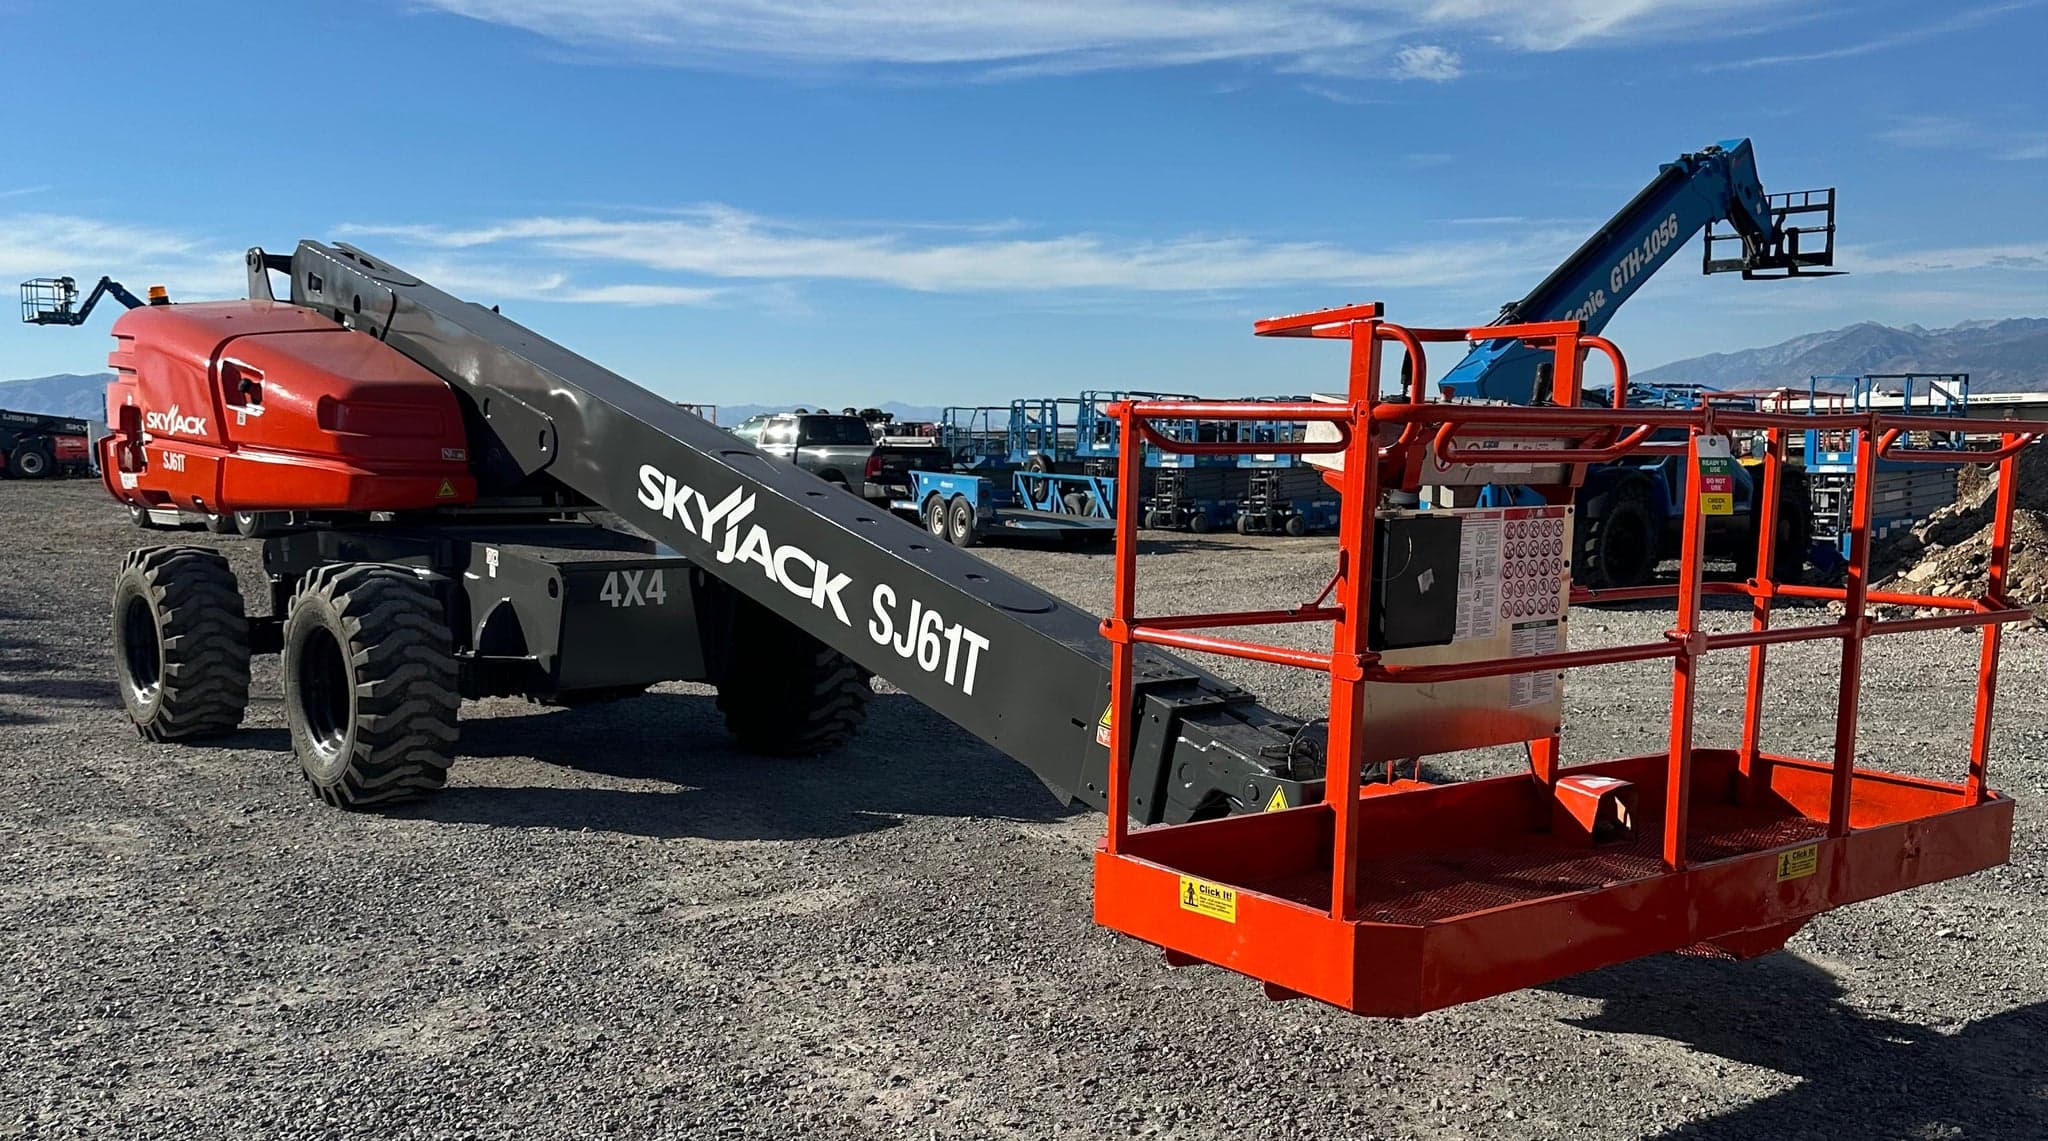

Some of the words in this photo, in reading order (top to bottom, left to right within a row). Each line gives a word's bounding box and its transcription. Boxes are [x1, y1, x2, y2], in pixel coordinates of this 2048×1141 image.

[1610, 213, 1678, 293] GTH-1056
[147, 404, 207, 435] SKYJACK
[163, 451, 186, 473] SJ61T
[600, 569, 667, 608] 4X4
[637, 463, 853, 627] SKYJACK
[868, 583, 990, 697] SJ61T
[1199, 885, 1221, 897] Click
